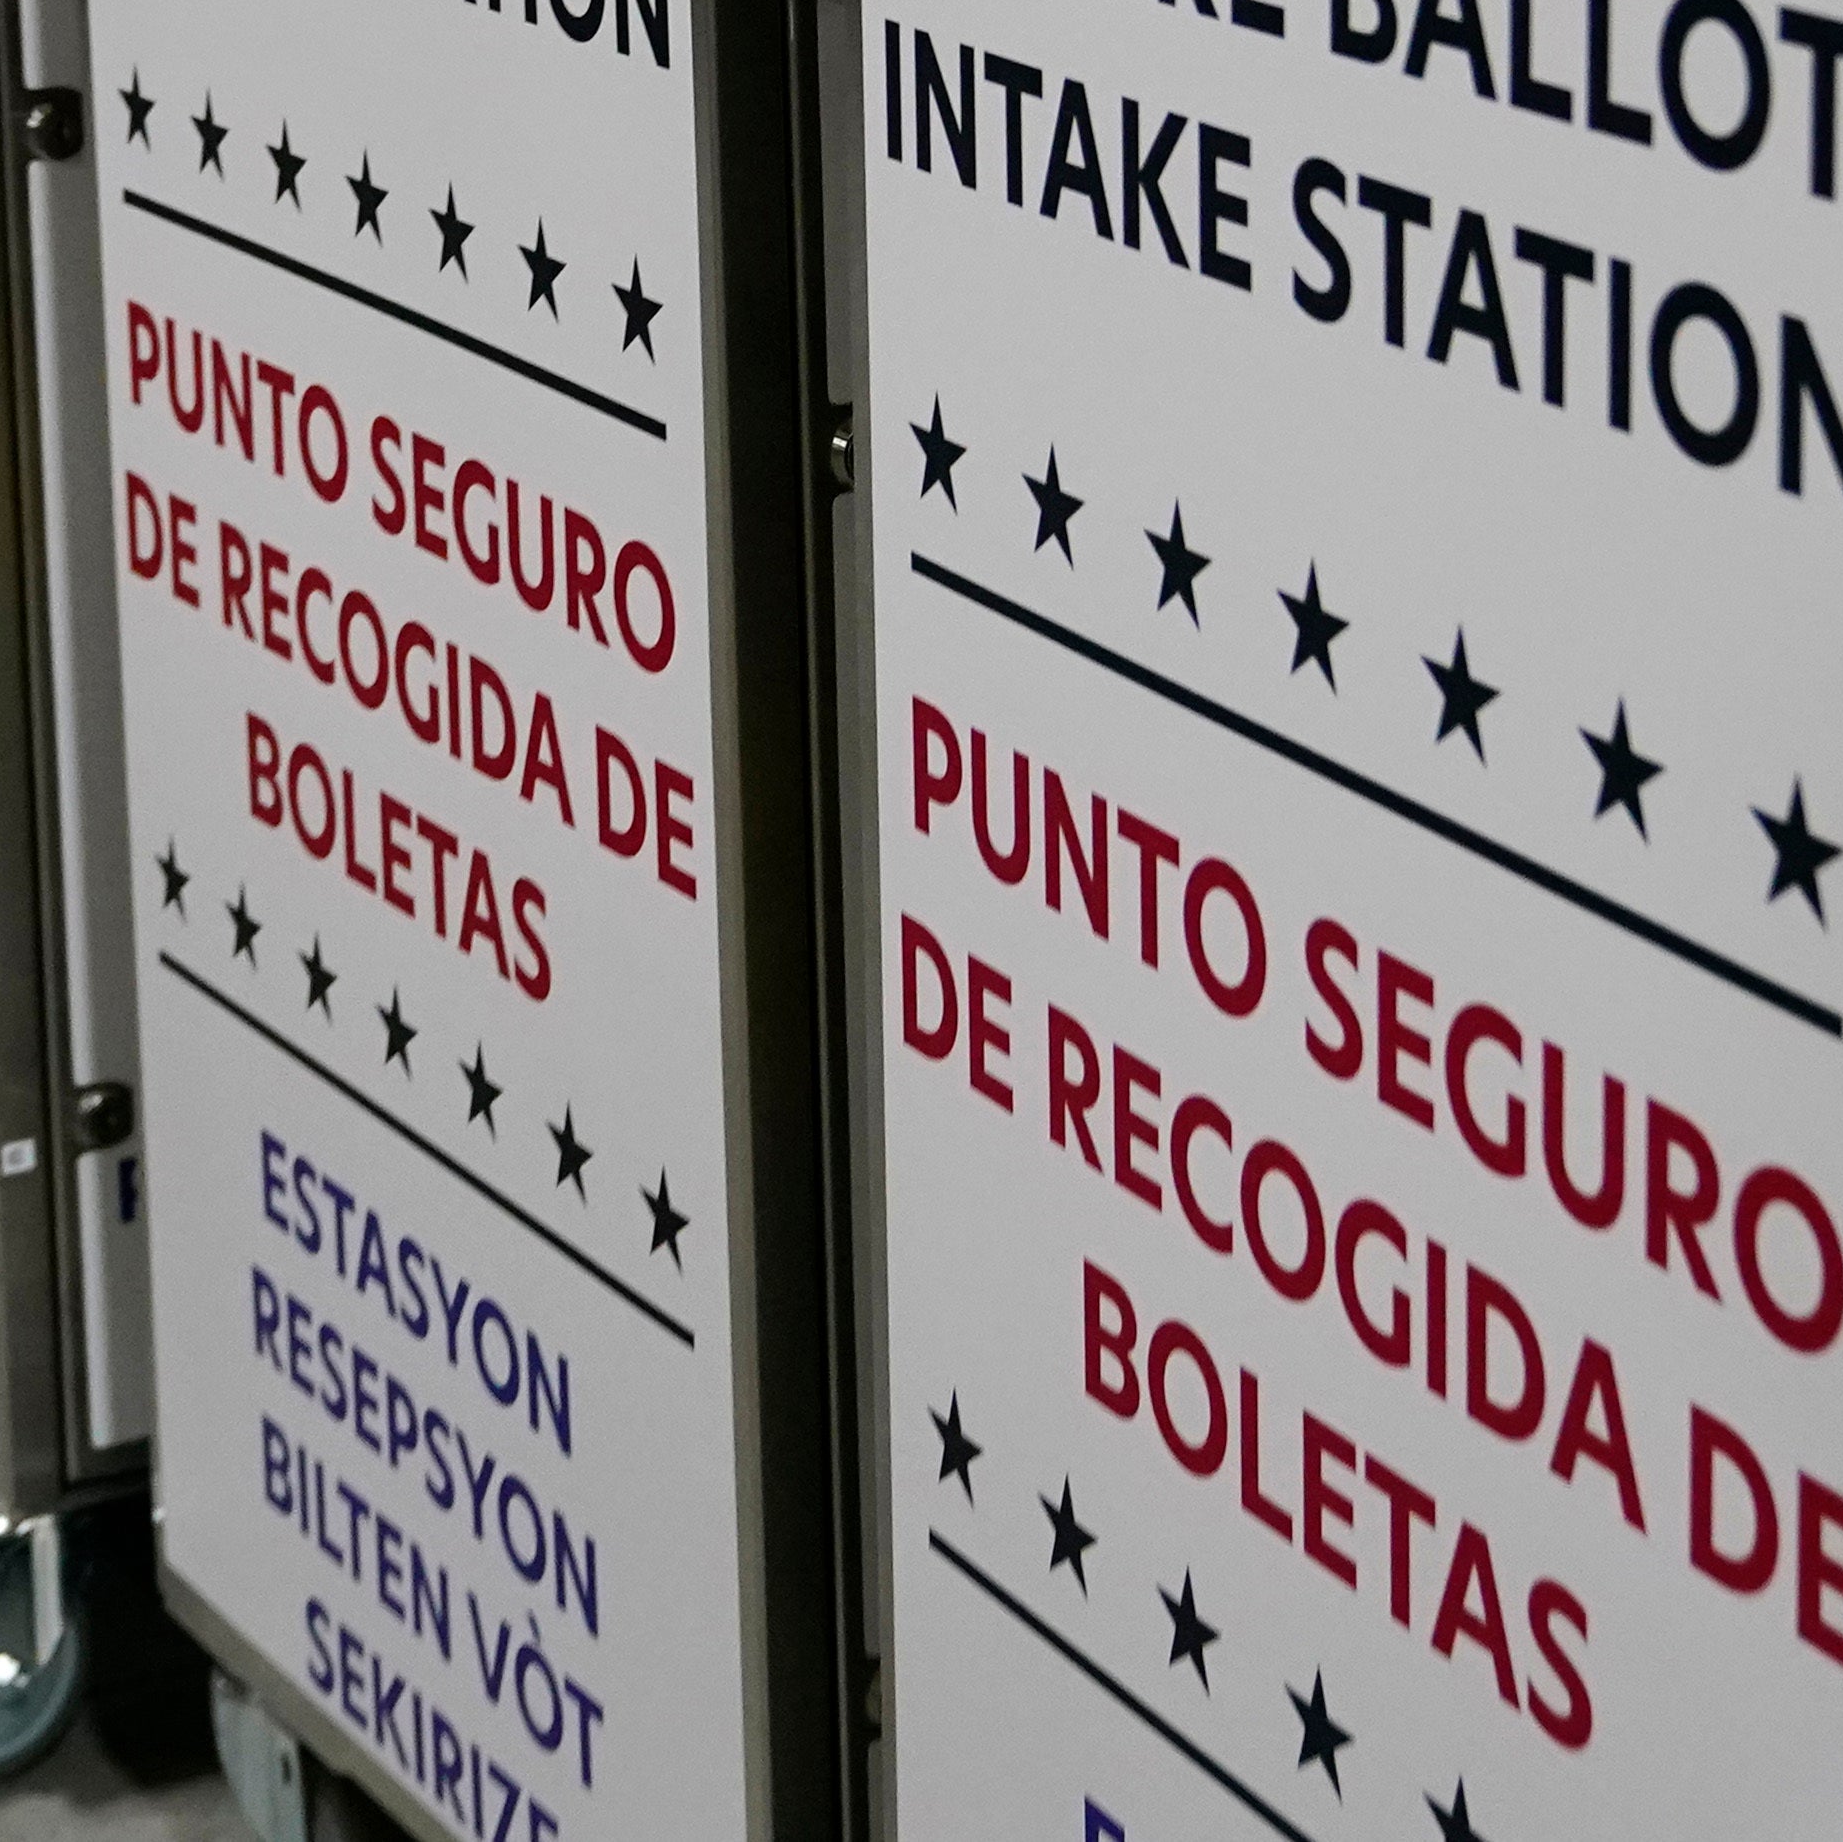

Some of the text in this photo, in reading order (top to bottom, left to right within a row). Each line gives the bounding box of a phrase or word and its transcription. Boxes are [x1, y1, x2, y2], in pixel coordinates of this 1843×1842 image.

[885, 19, 1252, 292] INTAKE
[128, 301, 675, 673] PUNTO SEGURO
[126, 472, 697, 900] DE RECOGIDA DE
[247, 713, 551, 1001] BOLETAS
[912, 696, 1267, 1018] PUNTO
[261, 1131, 571, 1456] ESTASYON
[901, 914, 1013, 1113] DE
[1048, 1004, 1646, 1533] RECOGIDA
[252, 1268, 598, 1637] RESEPSYON
[262, 1417, 603, 1788] BILTEN VÒT
[1084, 1260, 1592, 1750] BOLETAS
